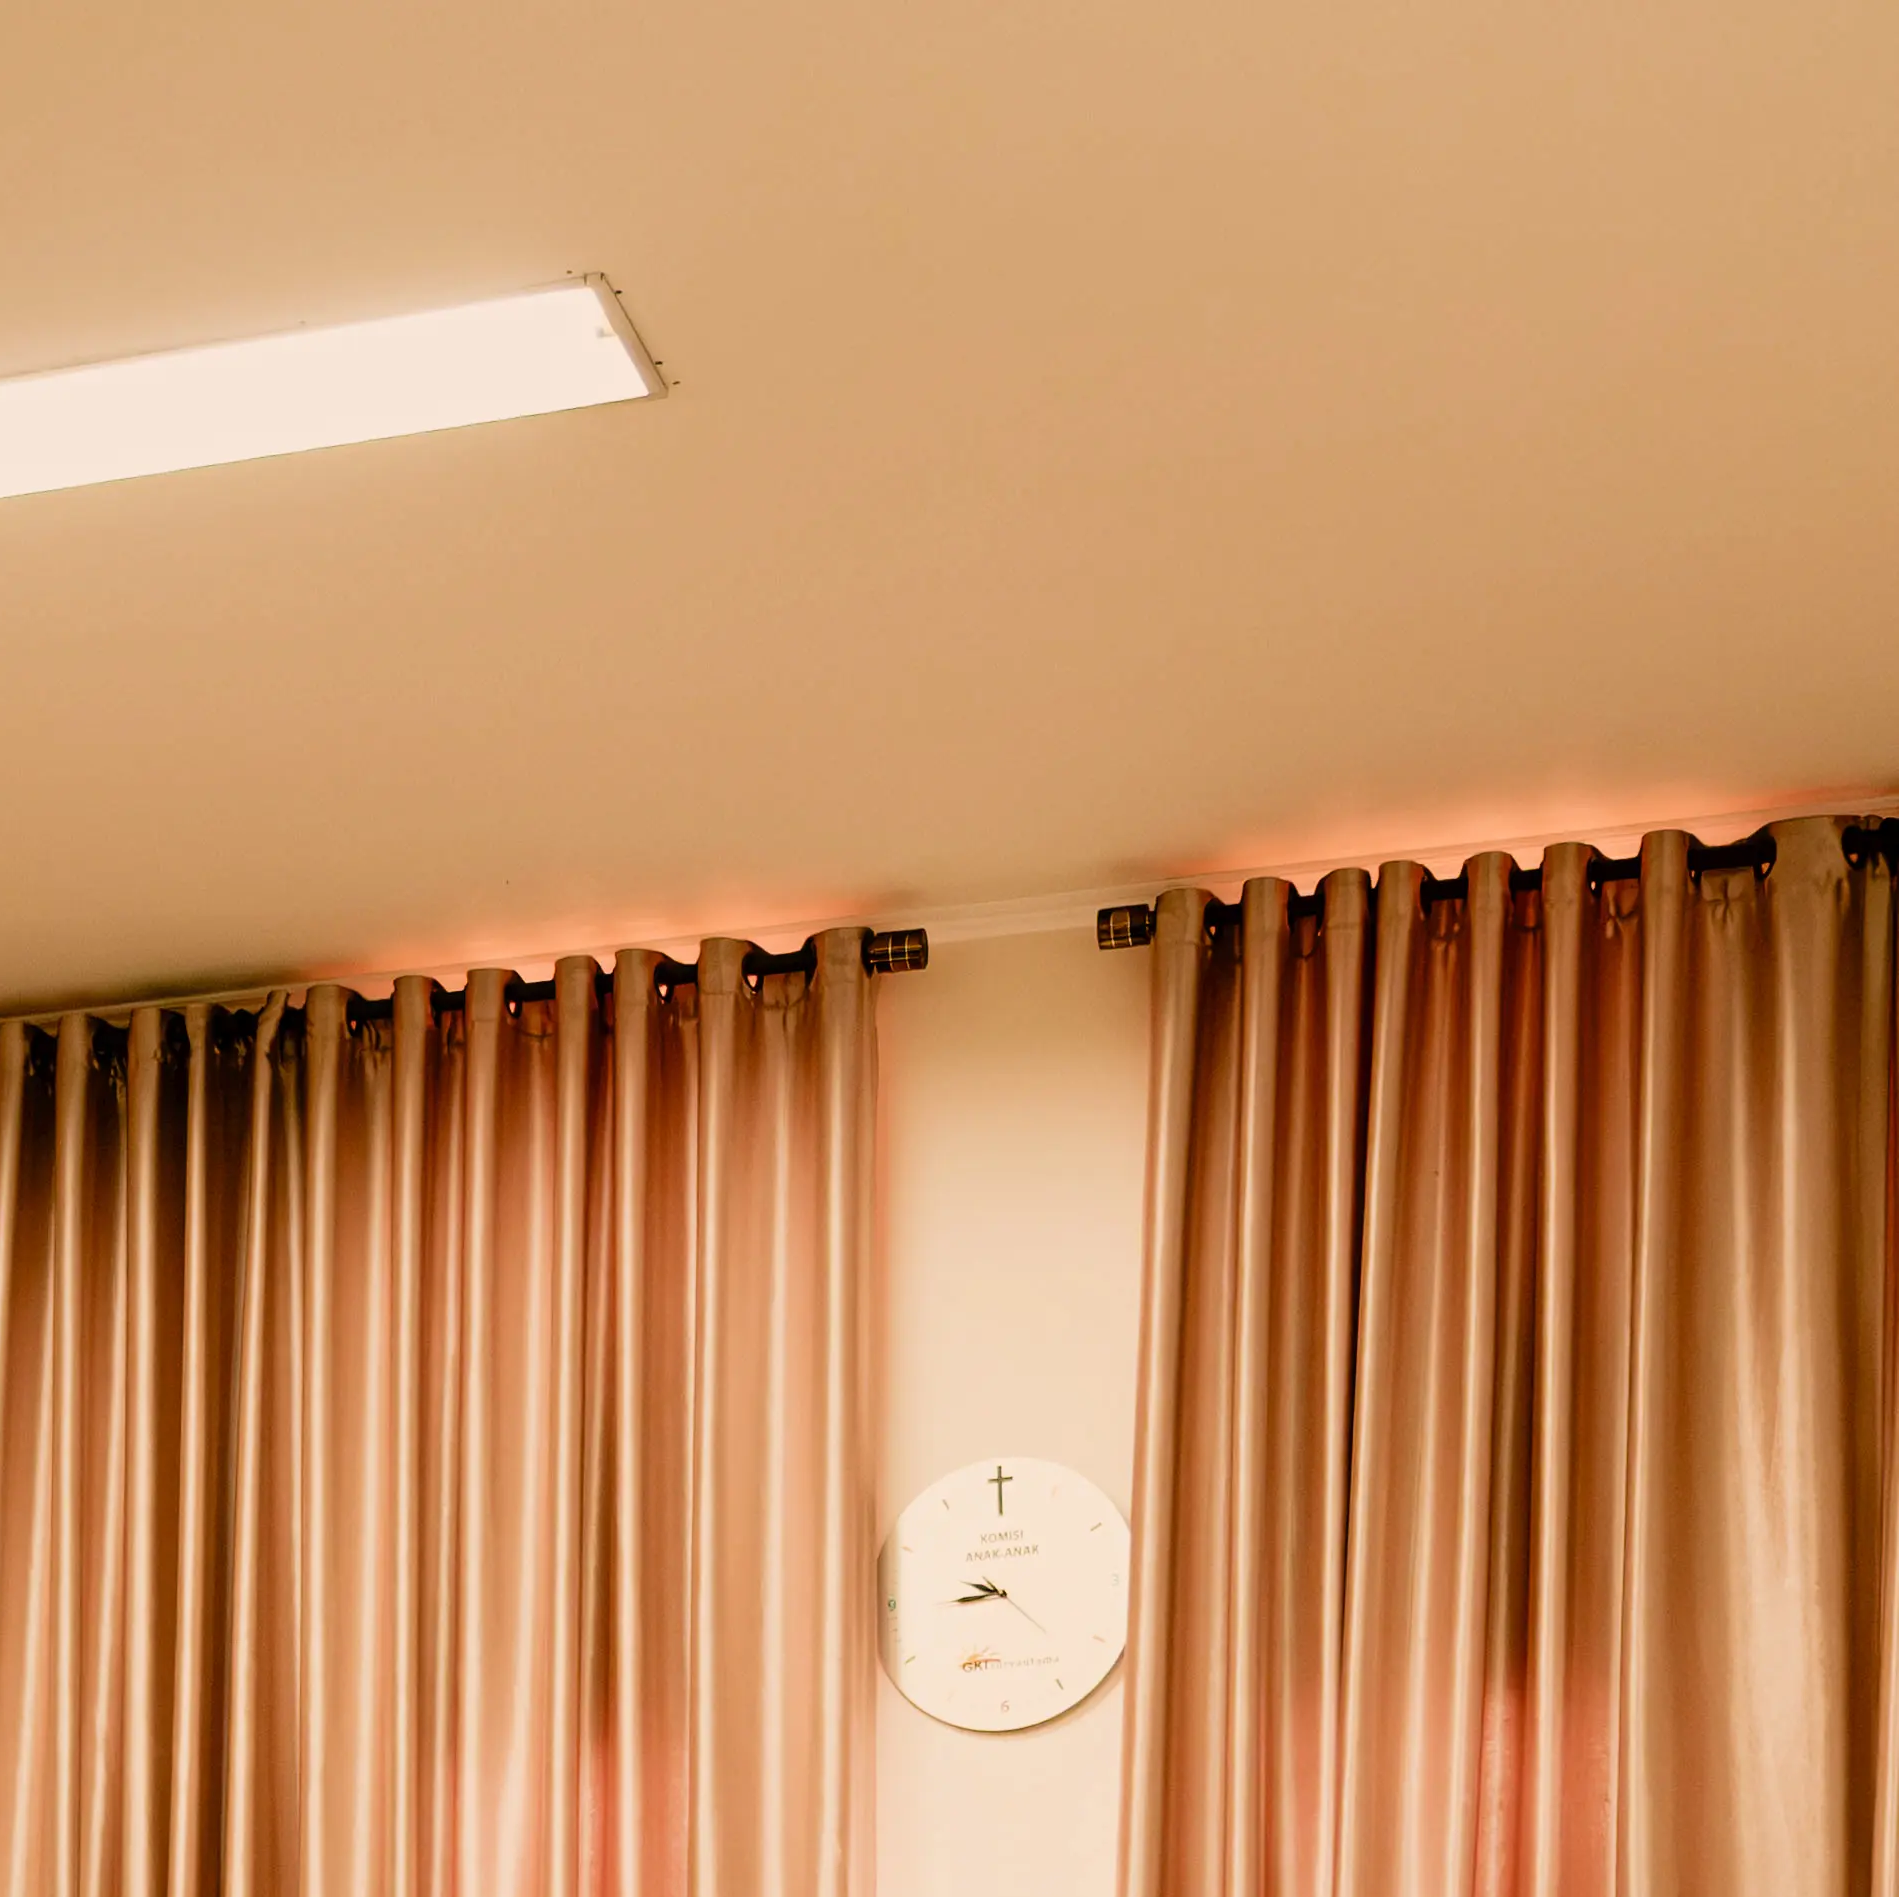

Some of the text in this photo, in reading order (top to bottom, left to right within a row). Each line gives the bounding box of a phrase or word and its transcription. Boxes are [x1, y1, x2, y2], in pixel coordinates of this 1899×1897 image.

[980, 1530, 1024, 1545] KOMISI
[966, 1544, 1040, 1562] ANAK-ANAK
[1111, 1573, 1120, 1587] 3
[1000, 1699, 1010, 1715] 6
